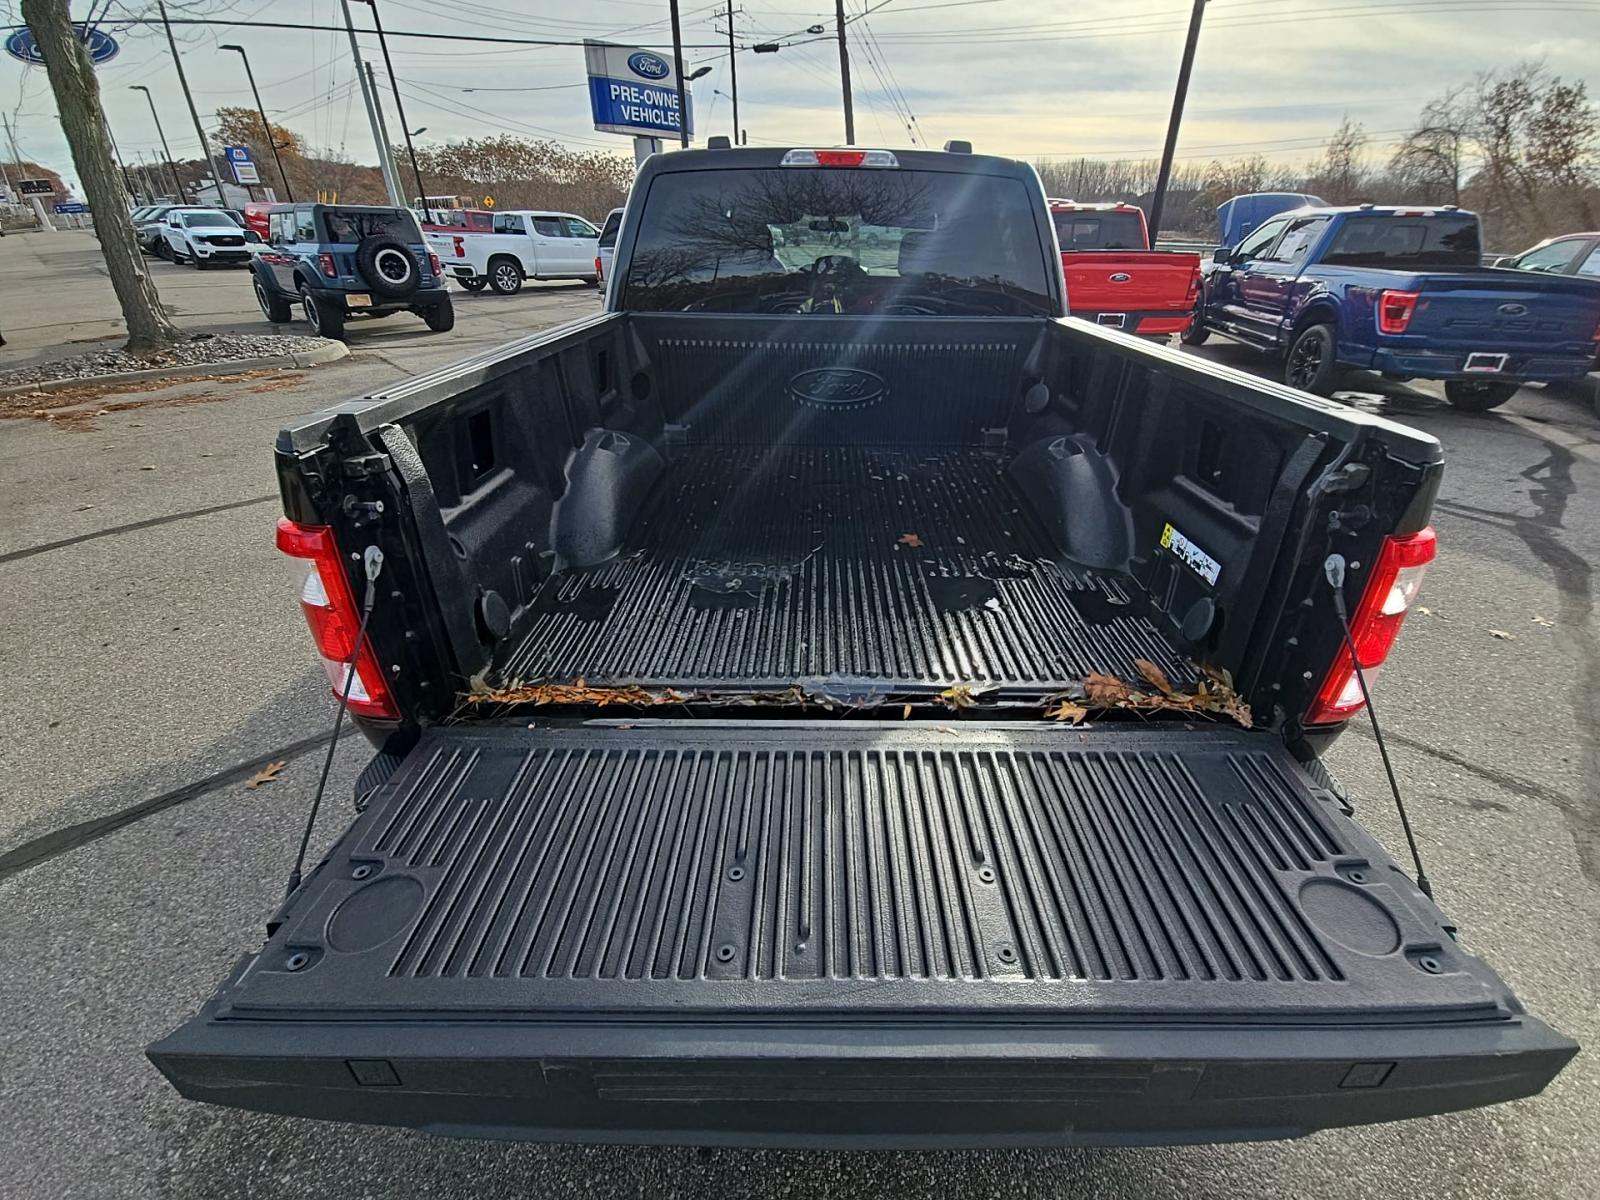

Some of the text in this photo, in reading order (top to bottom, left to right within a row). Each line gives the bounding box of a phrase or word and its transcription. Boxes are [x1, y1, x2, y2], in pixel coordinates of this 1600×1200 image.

[639, 57, 662, 74] Ford
[610, 84, 680, 109] PRE-OWNE
[621, 105, 681, 127] VEHICLES
[809, 371, 867, 396] Ford
